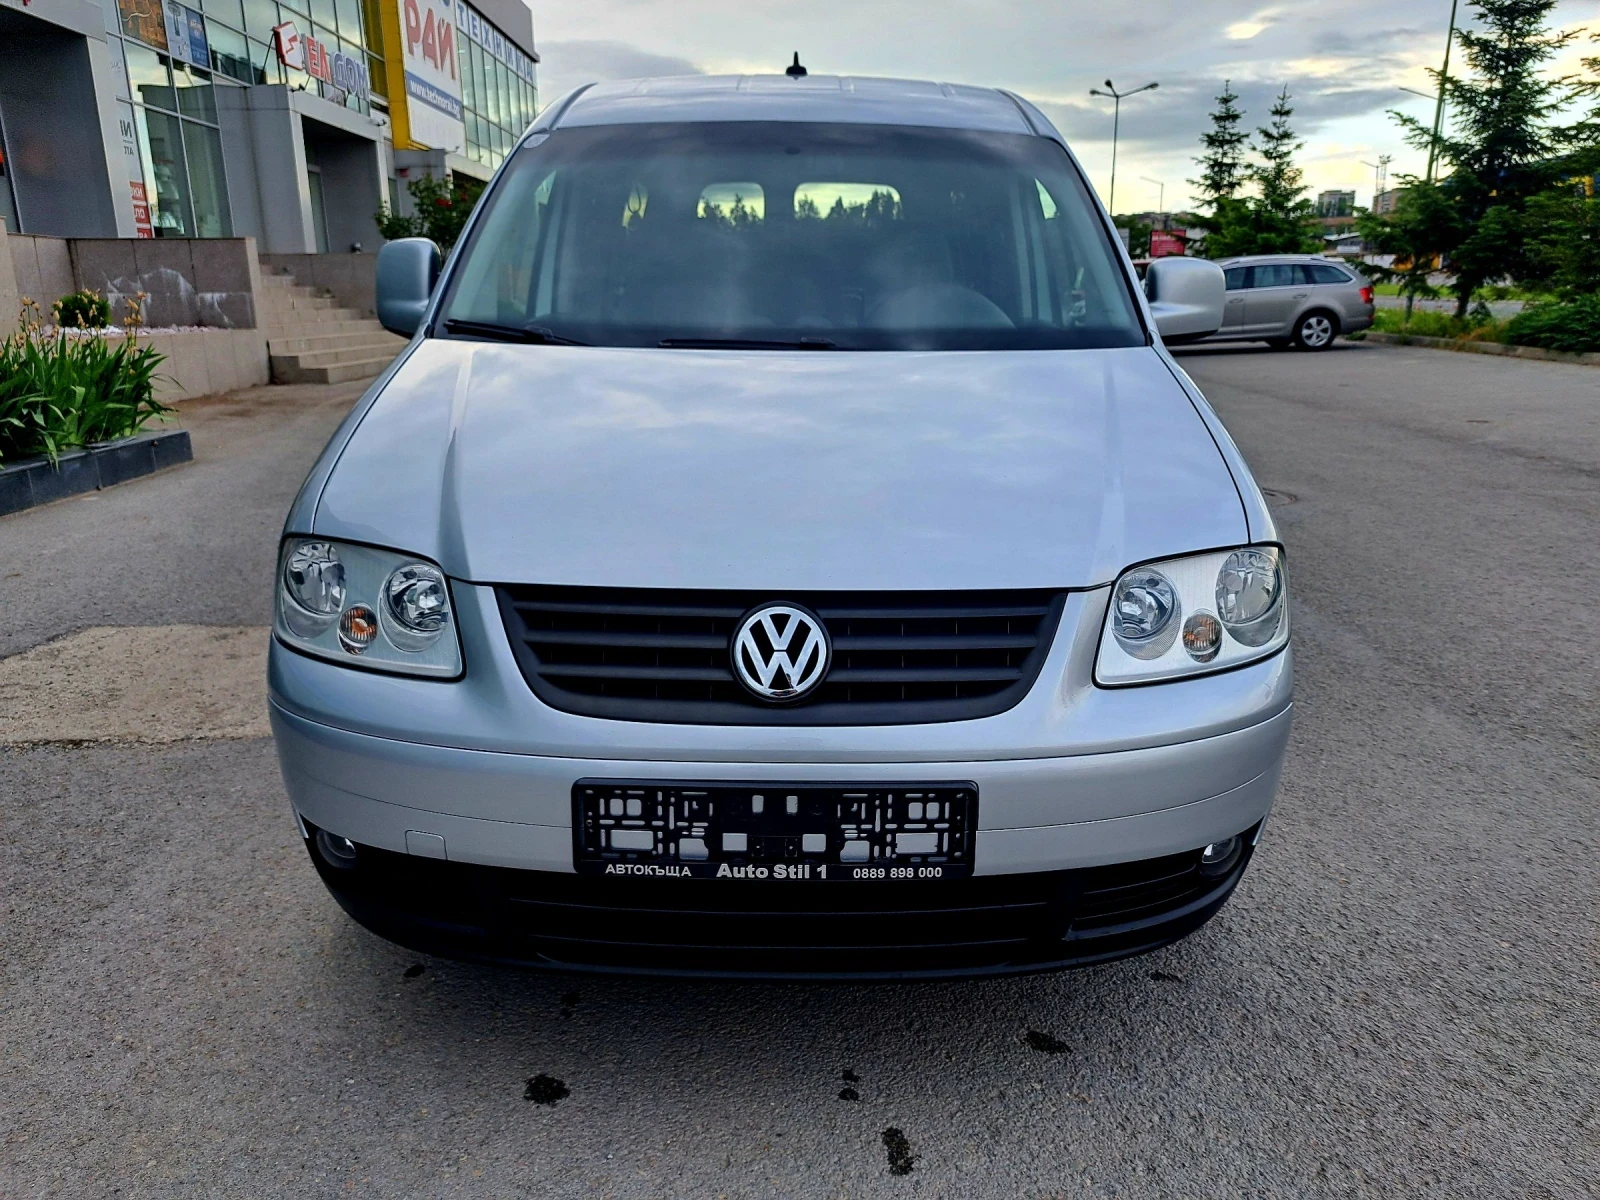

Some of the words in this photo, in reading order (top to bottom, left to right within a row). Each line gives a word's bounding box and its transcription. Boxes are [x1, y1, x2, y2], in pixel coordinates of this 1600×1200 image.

[605, 863, 692, 877] АВТОКЪЩА
[716, 863, 768, 878] Auto
[773, 864, 810, 879] Stil
[816, 864, 827, 879] 1
[853, 868, 886, 879] 0889
[890, 867, 914, 878] 898
[918, 867, 942, 878] 000
